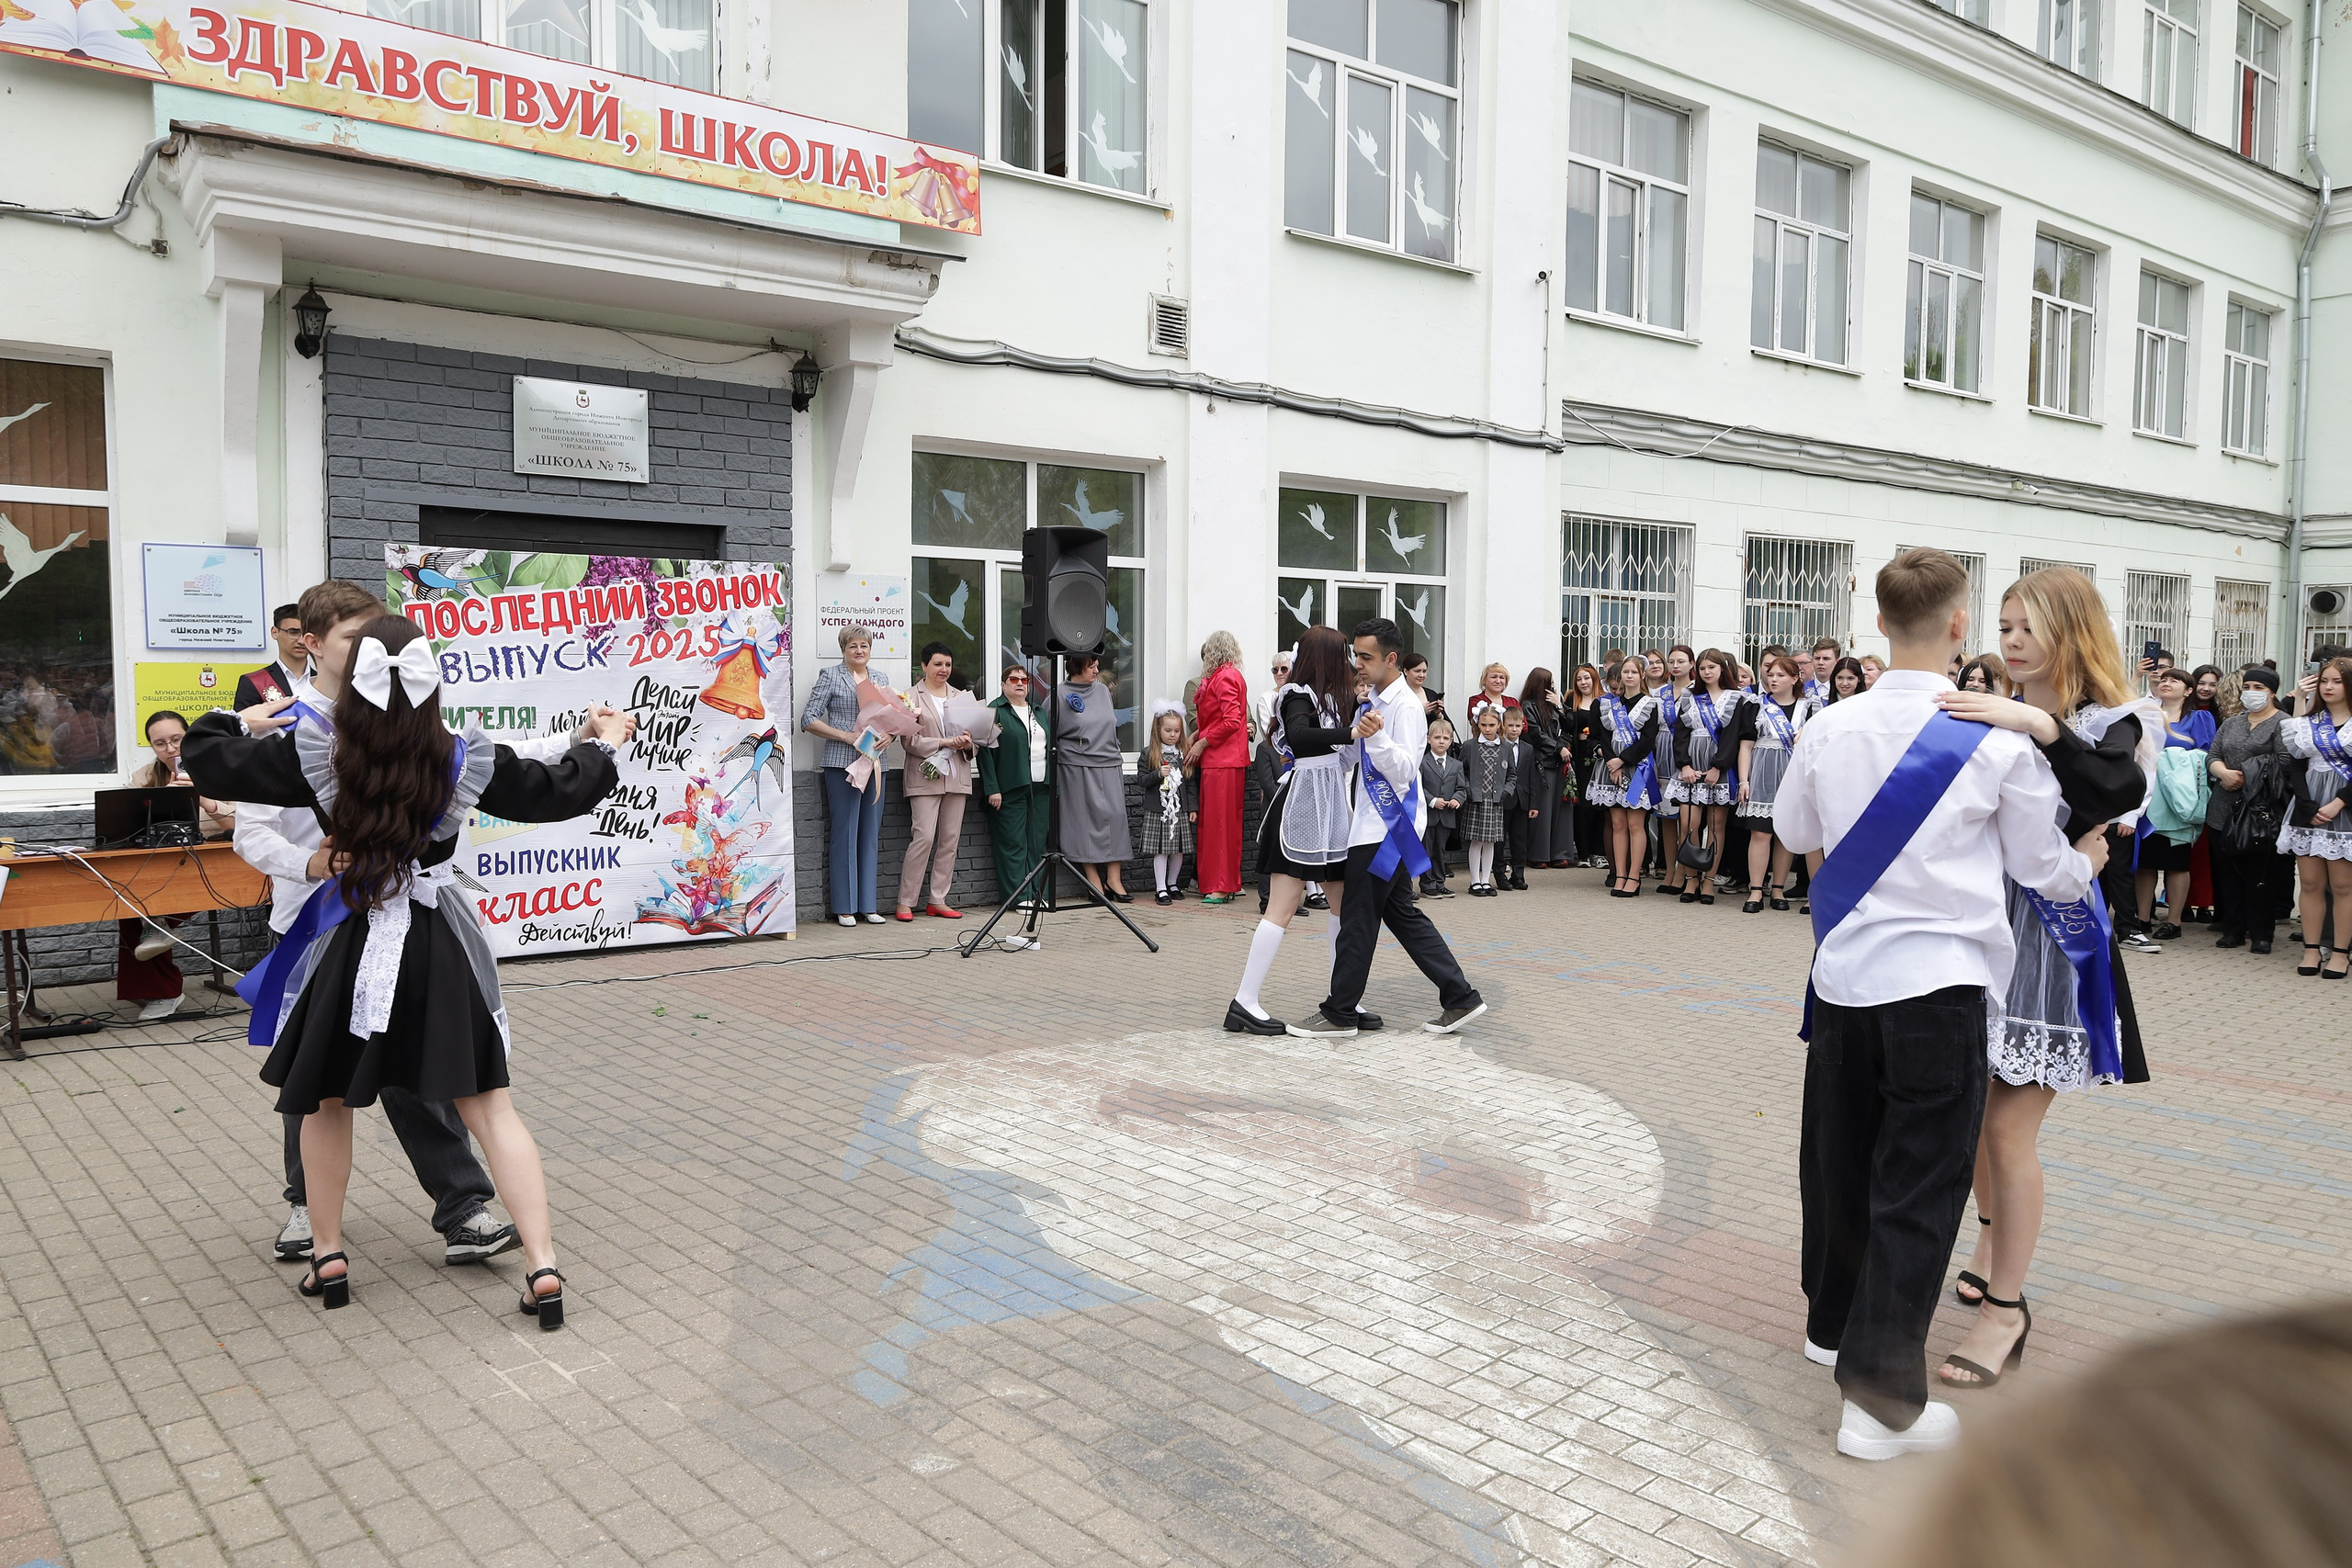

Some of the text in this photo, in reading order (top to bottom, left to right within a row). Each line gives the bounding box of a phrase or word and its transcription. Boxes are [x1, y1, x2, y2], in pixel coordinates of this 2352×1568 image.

[187, 7, 888, 197] ЗДРАВСТВУЙ, ШКОЛА!
[528, 406, 571, 416] Администрация
[552, 415, 587, 423] Департамент
[528, 425, 636, 442] МУНИЦИПАЛЬНОЕ БЮДЖЕТНОЕ
[540, 434, 625, 447] ОБЩЕОБРАЗОВАТЕЛЬНОЕ
[560, 442, 606, 452] УЧРЕЖДЕНИЕ
[527, 455, 637, 473] «ШКОЛА № 75»
[405, 573, 784, 639] ПОСЛЕДНИЙ ЗВОНОК
[820, 605, 876, 615] ФЕДЕРАЛЬНЫЙ
[820, 617, 905, 628] УСПЕХ КАЖДОГО
[170, 626, 210, 635] «Школа
[440, 625, 722, 684] ВЫПУСК 2025
[478, 845, 621, 877] ВЫПУСКНИК
[518, 908, 632, 949] Действуй!
